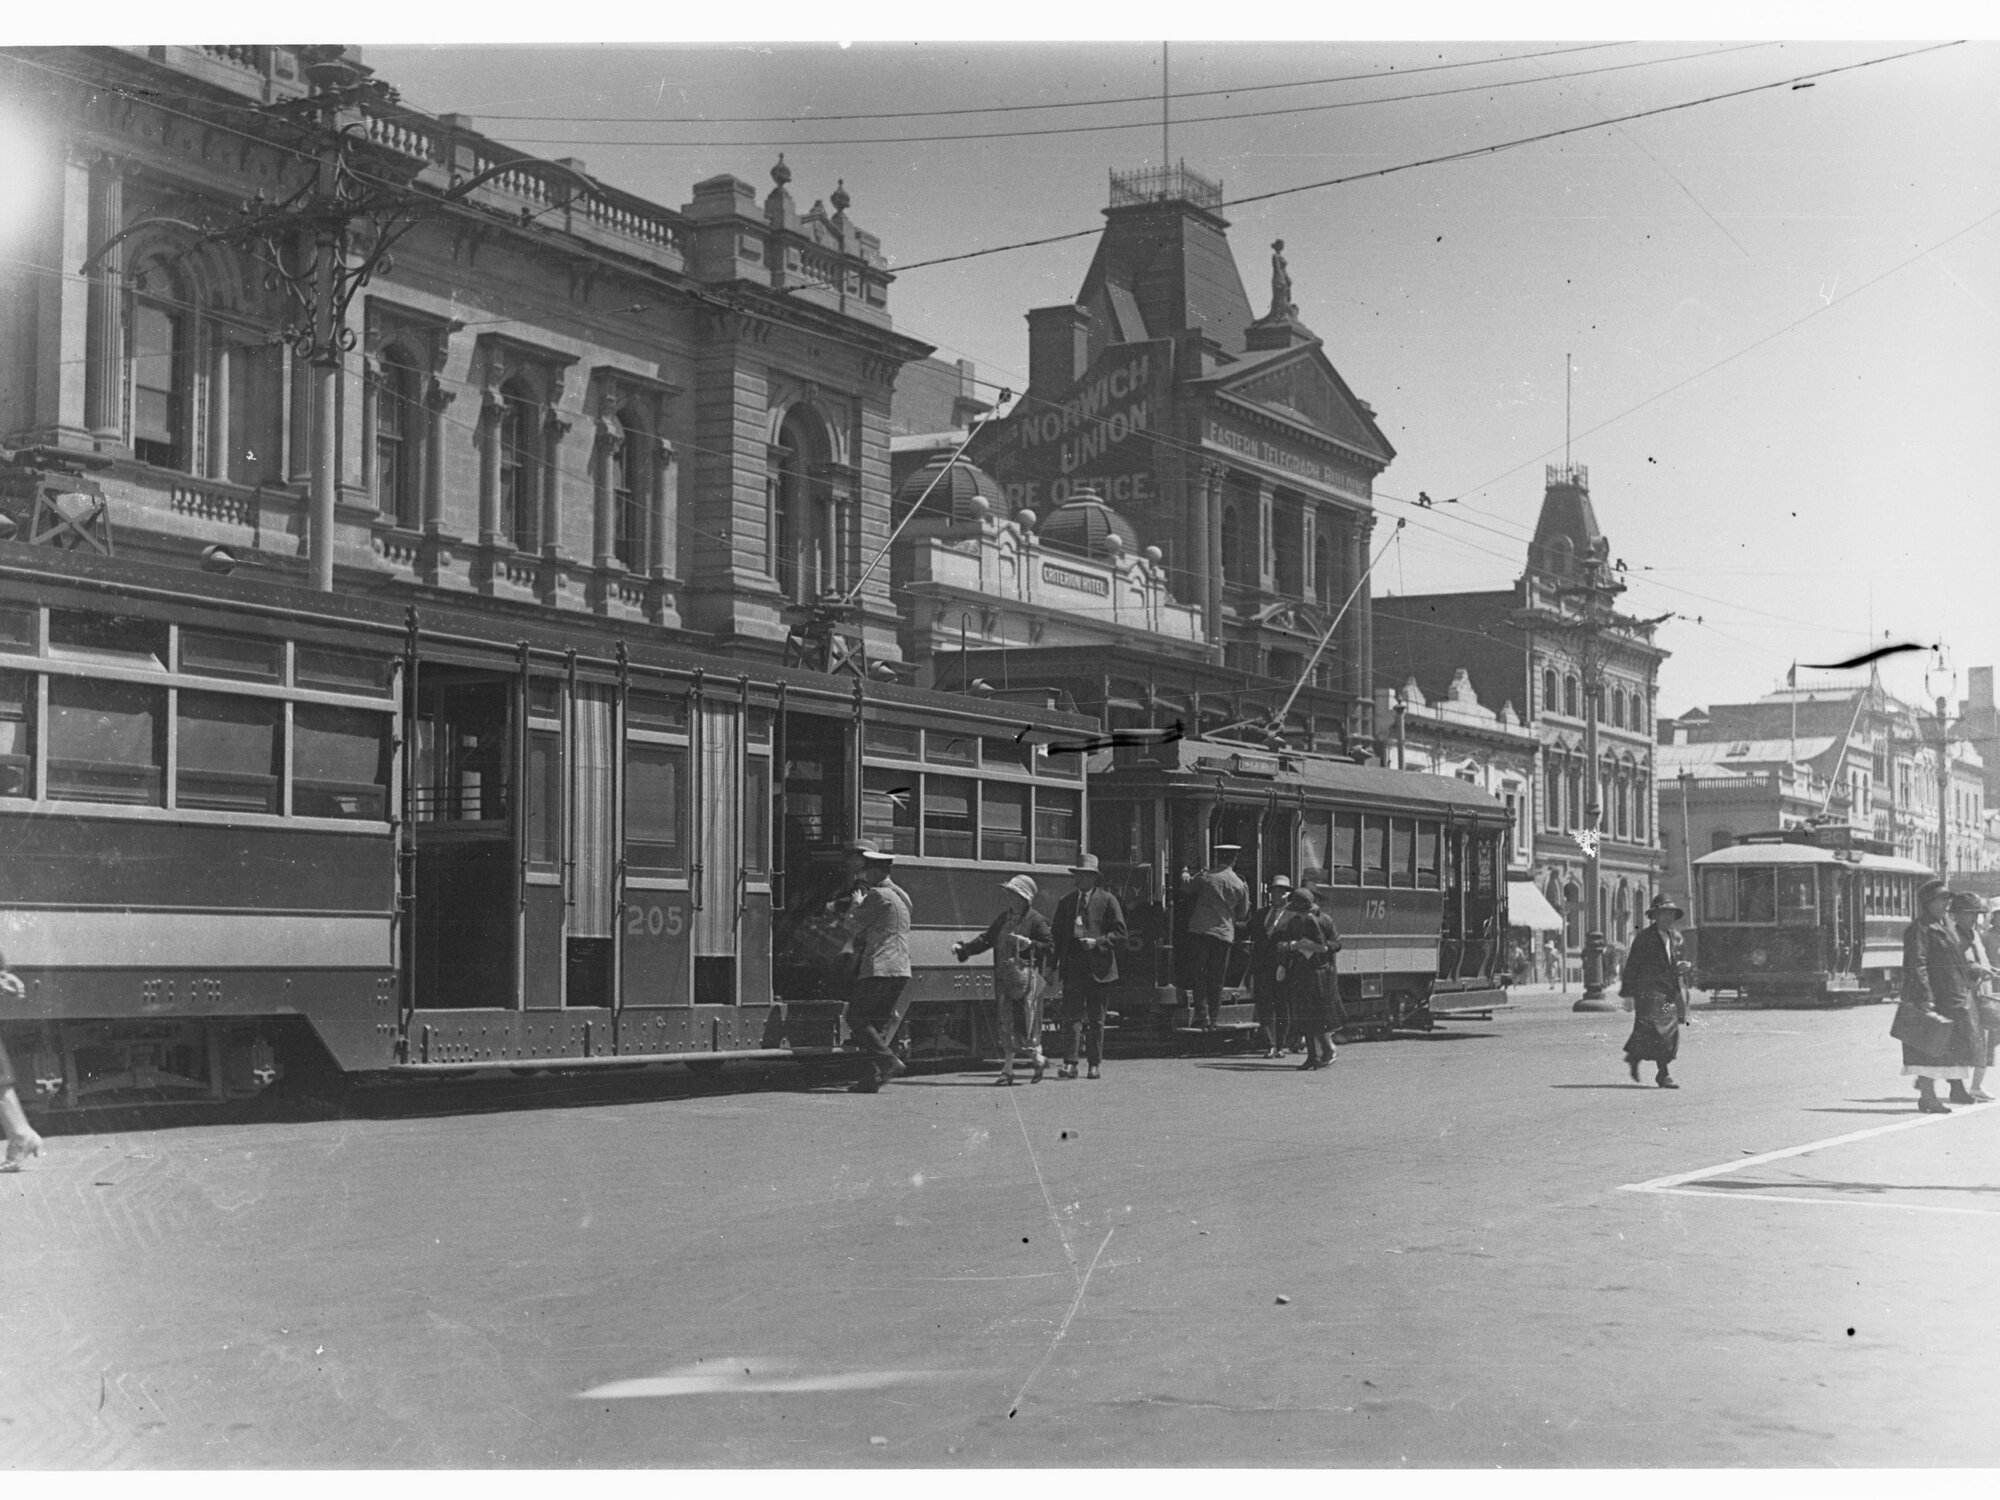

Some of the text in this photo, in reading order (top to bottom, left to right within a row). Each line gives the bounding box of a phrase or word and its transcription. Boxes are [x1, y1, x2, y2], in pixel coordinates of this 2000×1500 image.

[1021, 354, 1150, 449] NORWICH
[1060, 399, 1148, 474] UNION
[1209, 422, 1259, 457] EASTERN
[1262, 441, 1321, 480] TELEGRAPH
[1043, 566, 1106, 597] CRITERION HOTEL
[627, 904, 683, 936] 205
[1366, 899, 1386, 920] 176
